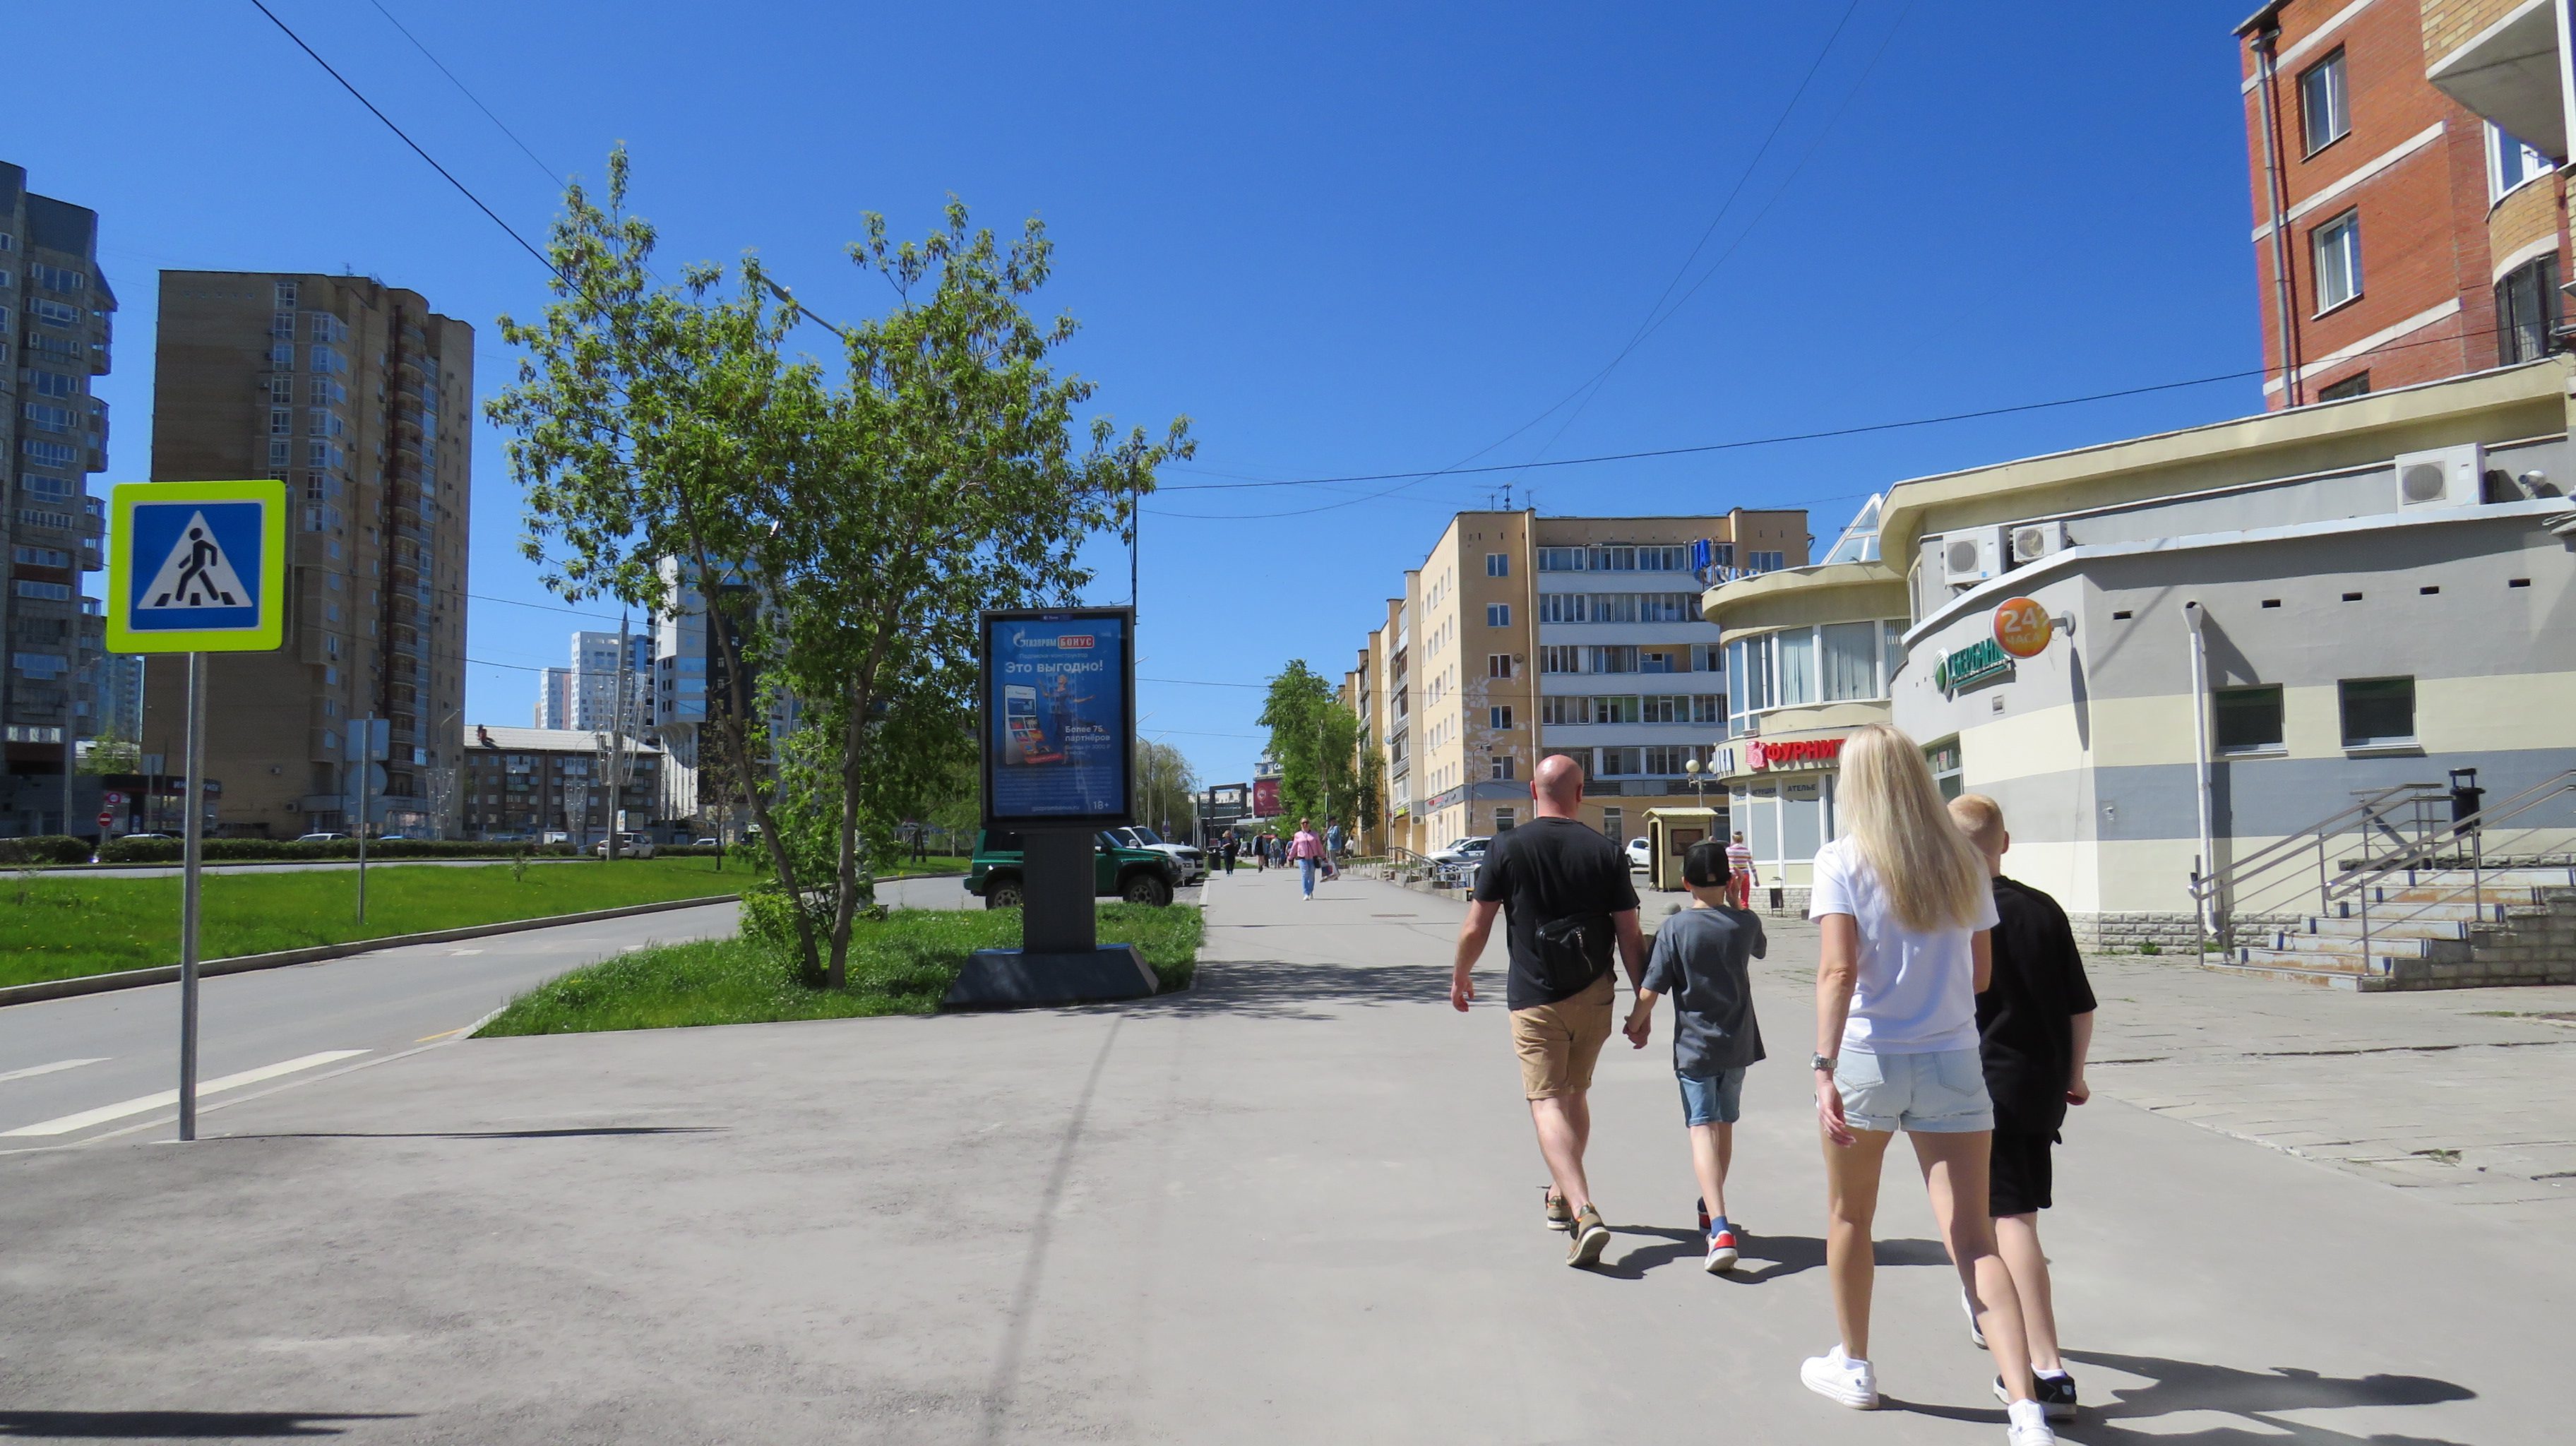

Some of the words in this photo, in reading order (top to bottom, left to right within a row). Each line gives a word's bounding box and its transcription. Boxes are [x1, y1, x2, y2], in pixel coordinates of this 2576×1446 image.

[2000, 607, 2038, 633] 24
[1025, 638, 1056, 647] ГАЗПРОМ
[1060, 638, 1092, 647] БОНУС
[2005, 632, 2041, 645] ЧАСА
[1005, 662, 1032, 673] Это
[1037, 659, 1103, 674] выгодно!
[1065, 734, 1110, 743] партнёров
[1787, 784, 1816, 792] АТЕЛЬЕ
[1093, 801, 1109, 809] 18+
